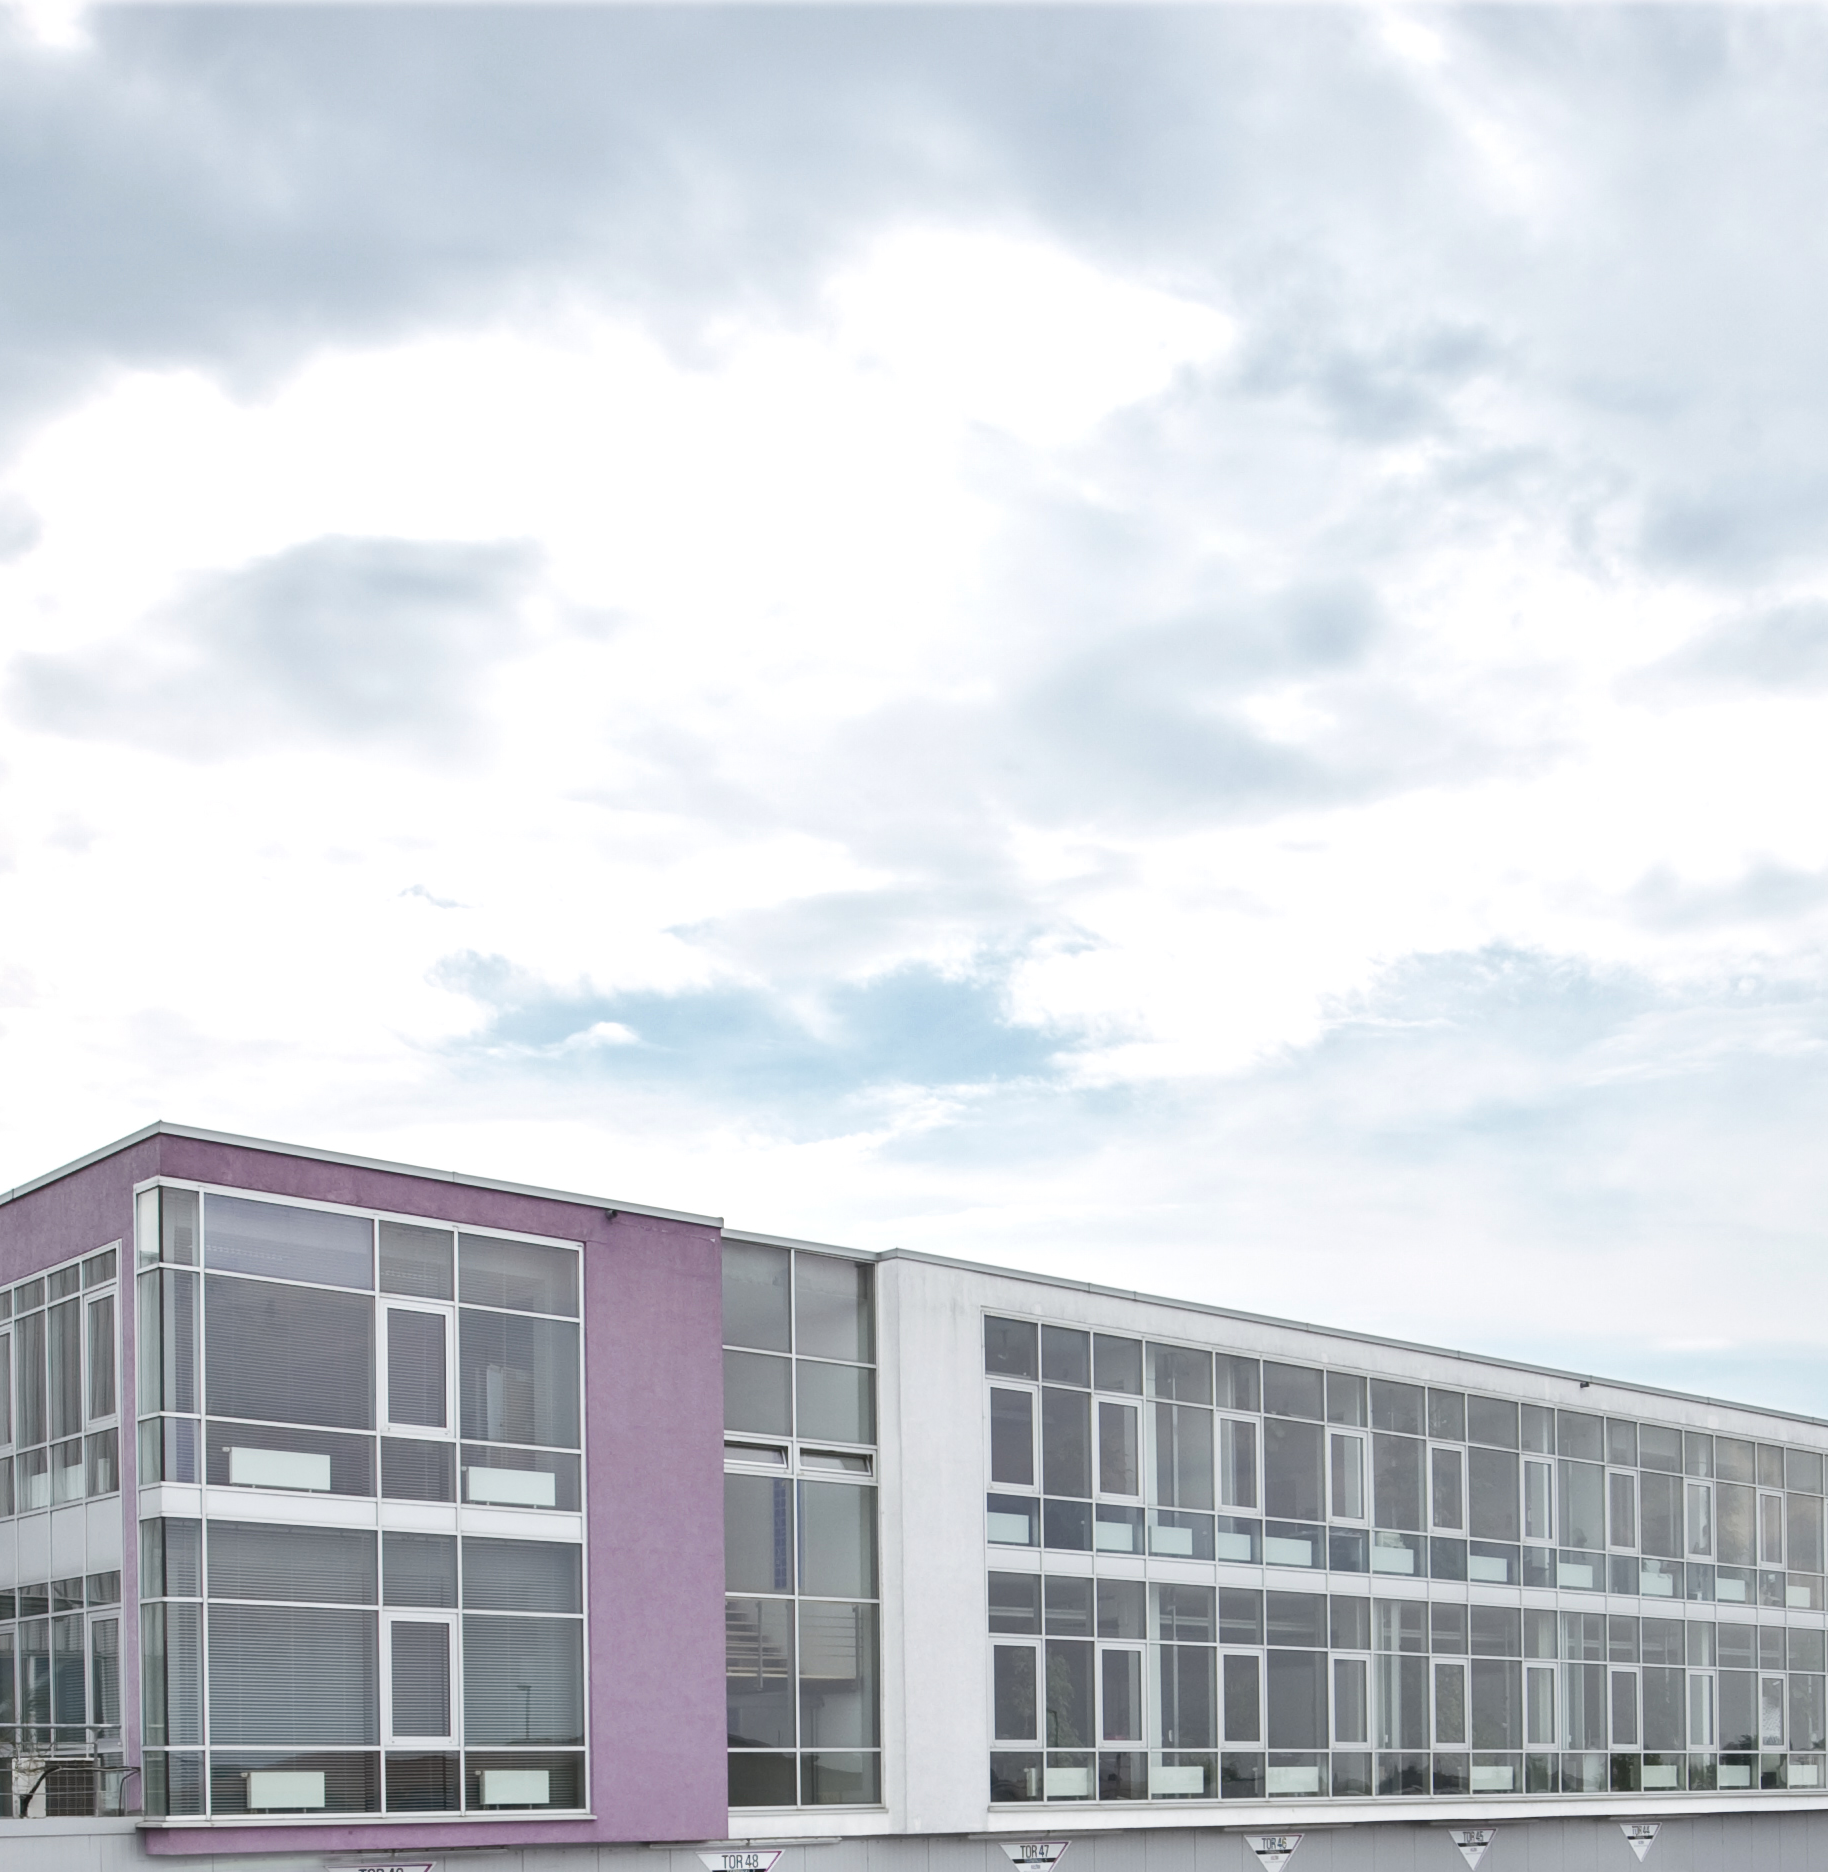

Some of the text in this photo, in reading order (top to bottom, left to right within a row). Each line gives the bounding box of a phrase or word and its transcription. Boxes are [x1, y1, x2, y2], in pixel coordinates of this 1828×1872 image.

[1261, 1837, 1276, 1850] TOR
[1020, 1844, 1049, 1859] TOR 47
[721, 1853, 759, 1869] TOR 48
